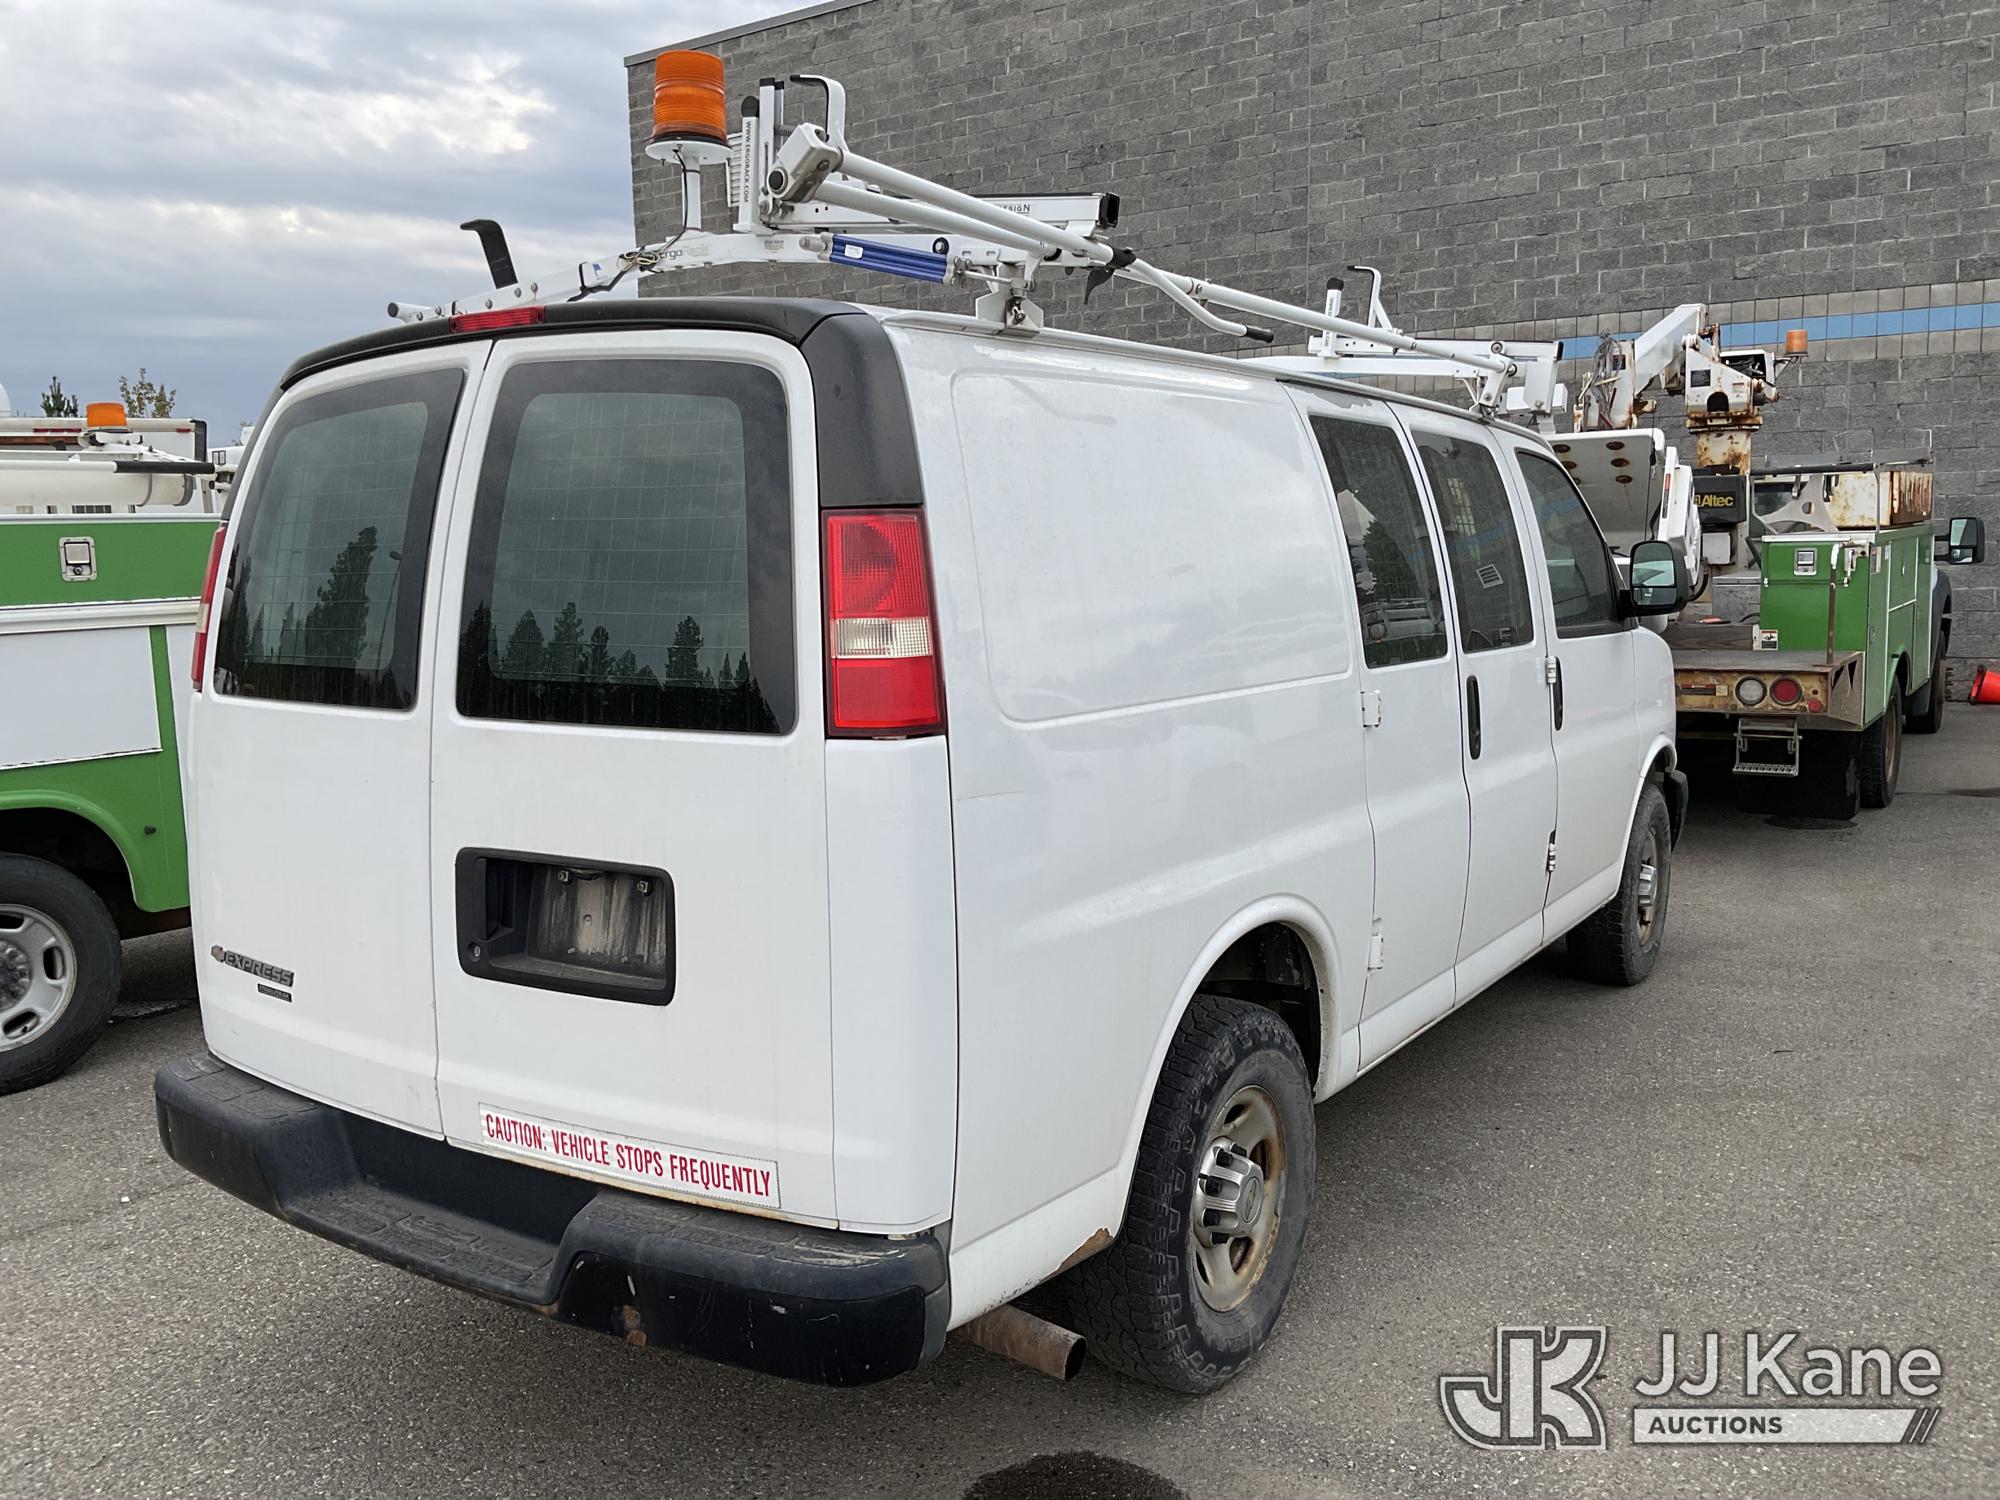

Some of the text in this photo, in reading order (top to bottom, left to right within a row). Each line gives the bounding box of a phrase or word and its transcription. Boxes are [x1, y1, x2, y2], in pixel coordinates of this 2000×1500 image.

[1700, 494, 1734, 507] Altec
[225, 951, 294, 987] EXPRESS
[485, 1113, 771, 1197] CAUTION: VEHICLE STOPS FREQUENTLY
